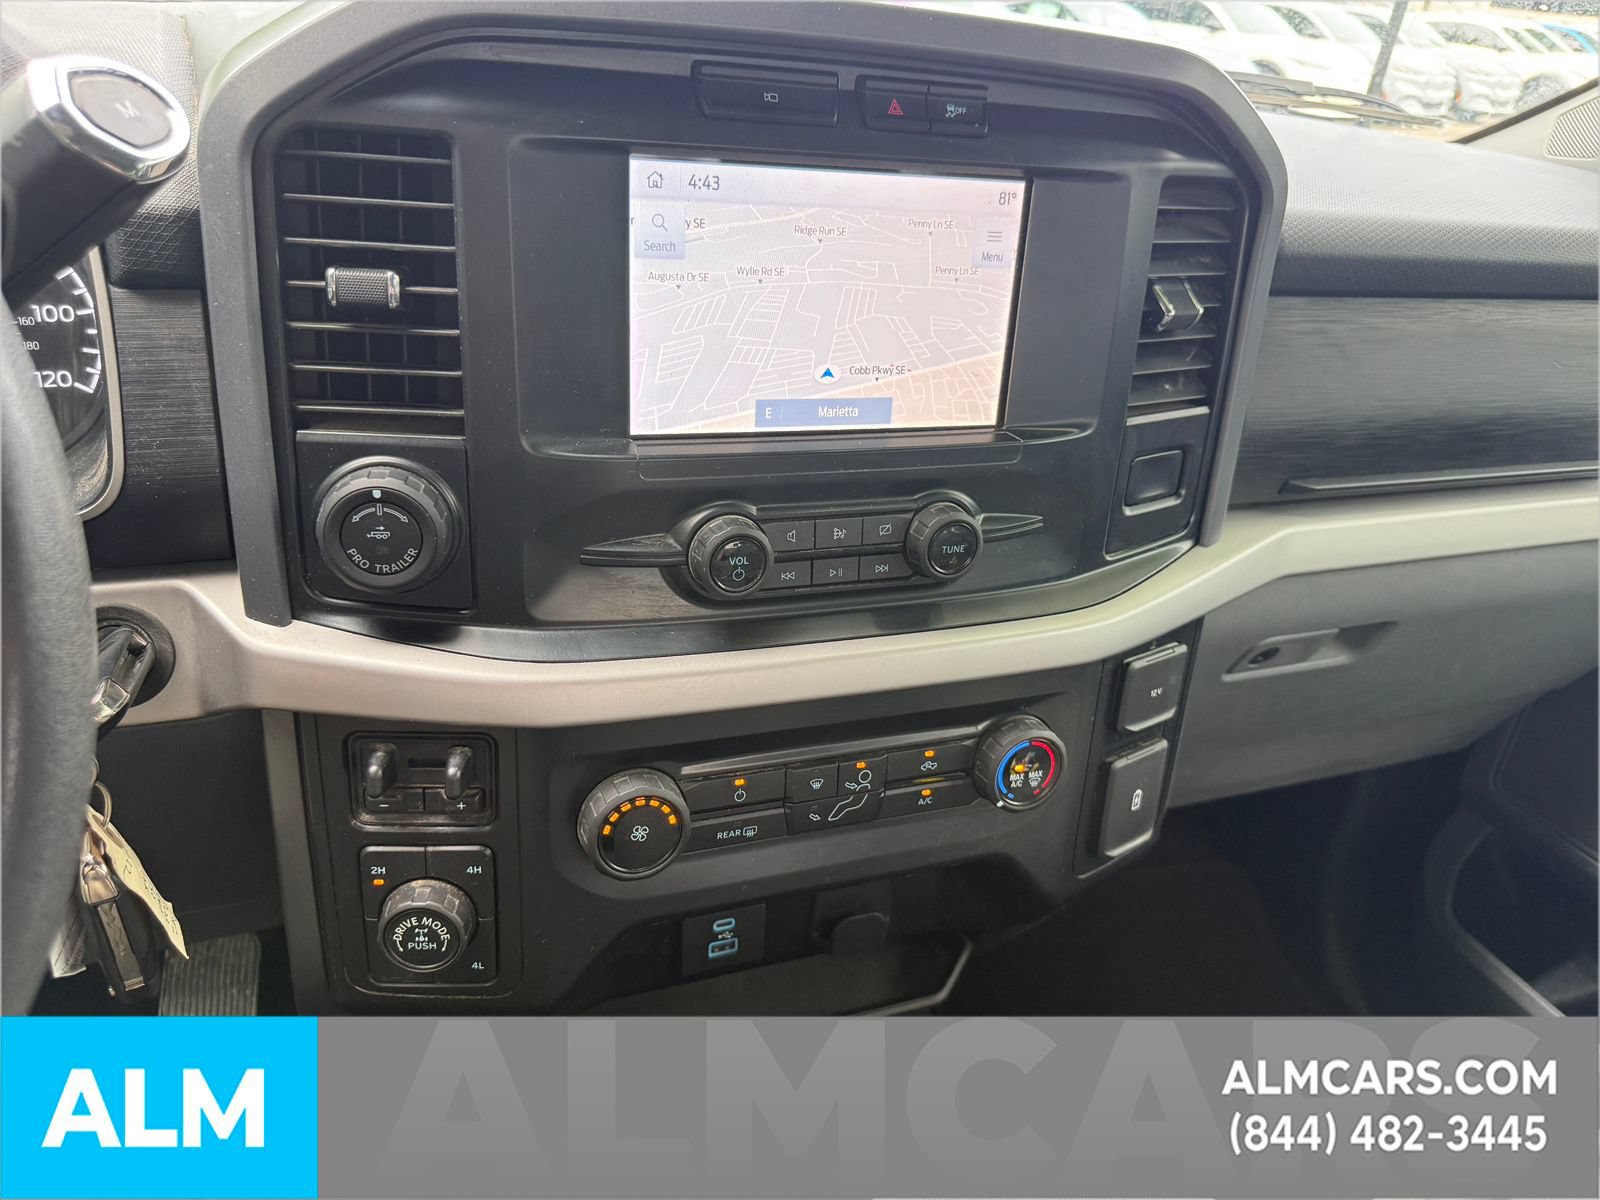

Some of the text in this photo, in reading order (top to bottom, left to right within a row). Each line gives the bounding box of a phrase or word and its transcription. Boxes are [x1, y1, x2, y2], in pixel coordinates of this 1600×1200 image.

[954, 106, 967, 115] OFF
[687, 174, 721, 191] 4:43
[998, 192, 1017, 206] 81°
[693, 217, 706, 229] SE
[908, 218, 954, 230] Penny Ln SE
[794, 225, 847, 237] Ridge Run SE
[643, 240, 676, 252] Search
[981, 252, 1004, 262] Menu
[648, 271, 709, 283] Augusta Dr SE
[736, 265, 785, 278] Wylie Rd SE
[935, 266, 979, 277] Penny Ln SE
[30, 304, 75, 323] 100
[18, 316, 35, 326] 160
[849, 365, 906, 376] Cobb Pkwy SE
[34, 370, 73, 388] 120
[765, 408, 773, 419] E
[818, 406, 859, 418] Marietta
[941, 544, 966, 554] TUNE
[346, 548, 370, 570] PRO
[374, 547, 419, 574] TRAILER
[728, 555, 749, 566] VOL
[1009, 773, 1025, 782] MAX
[1028, 769, 1044, 779] MAX
[1010, 780, 1023, 788] A/C
[917, 797, 933, 806] A/C
[716, 828, 742, 841] REAR
[370, 866, 386, 875] 2H
[466, 865, 482, 875] 4H
[393, 916, 451, 942] DRIVE MODE
[407, 941, 437, 950] PUSH
[471, 961, 485, 970] 4L
